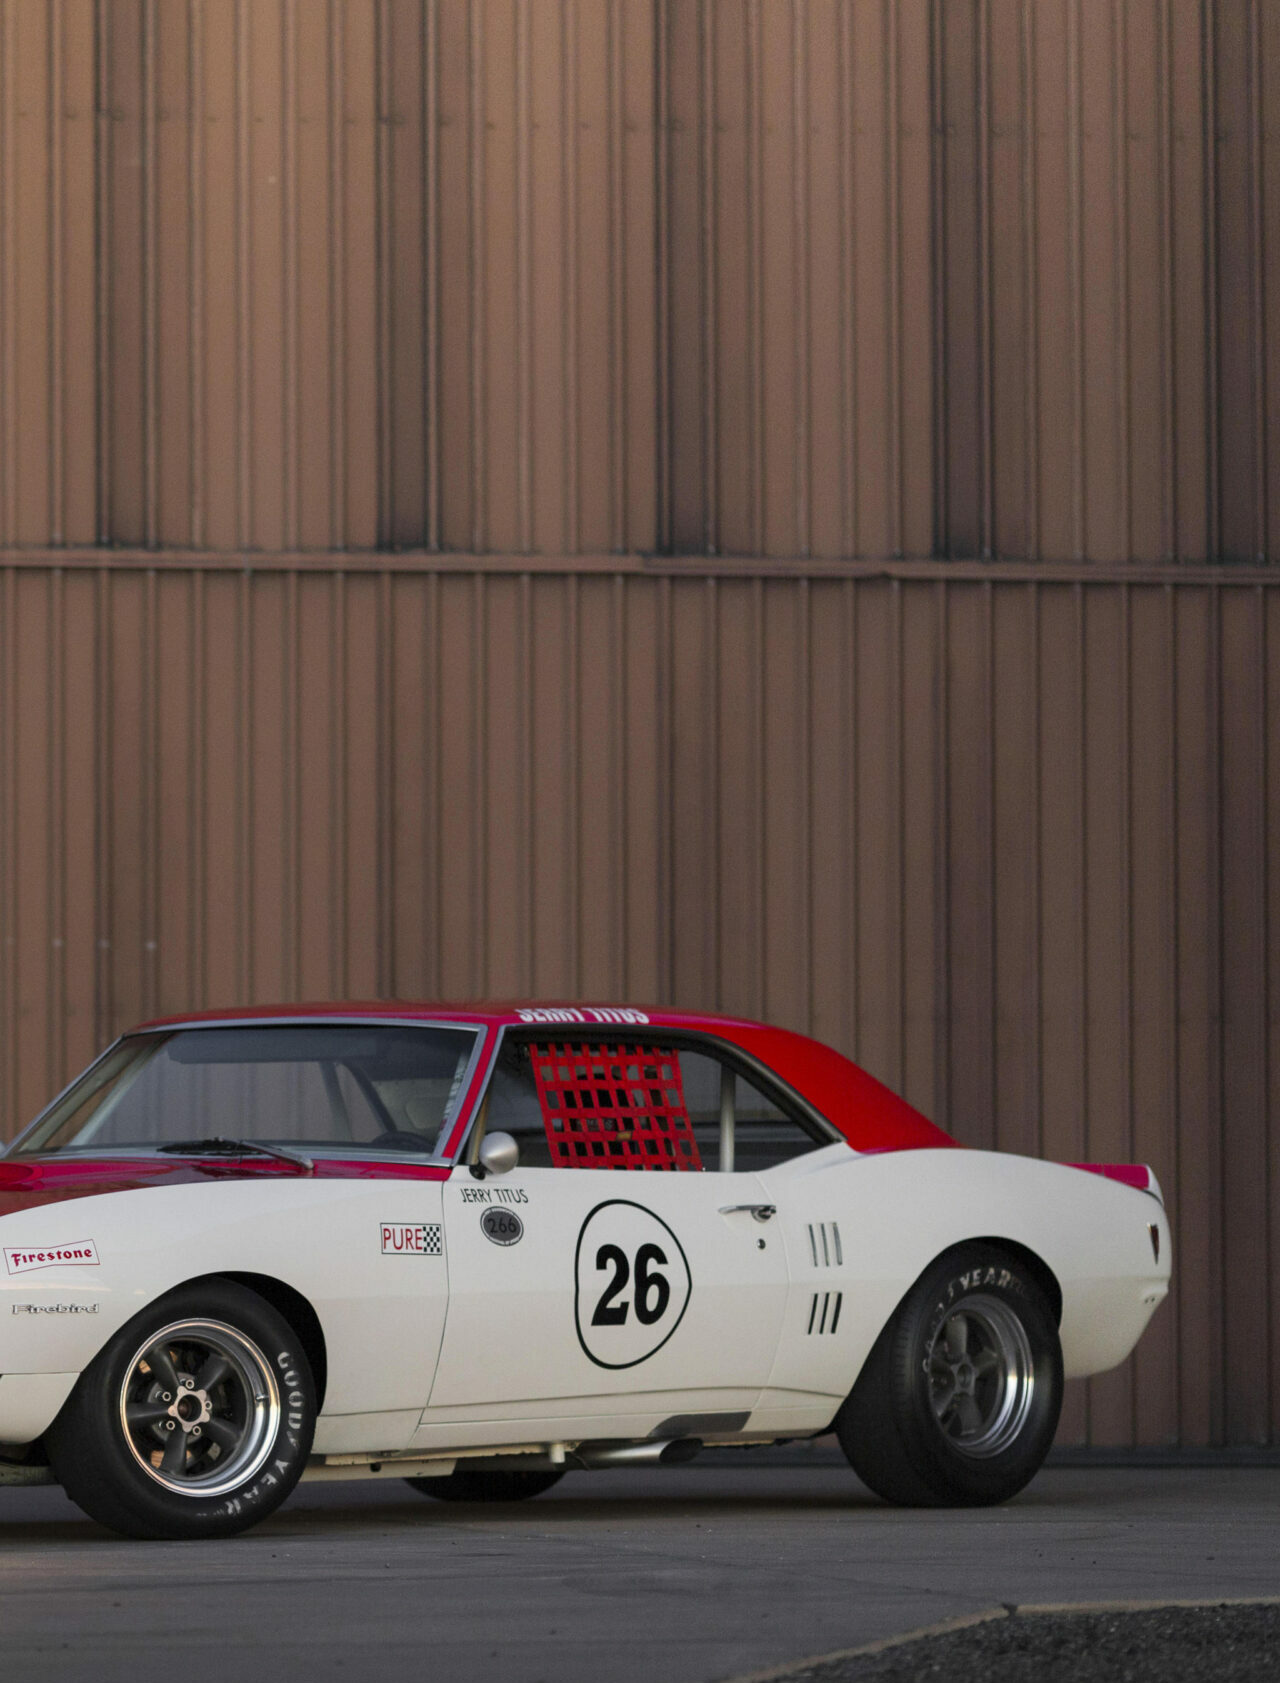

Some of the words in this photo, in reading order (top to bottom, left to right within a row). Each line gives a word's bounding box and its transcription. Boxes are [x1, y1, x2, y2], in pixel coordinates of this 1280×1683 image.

[460, 1188, 492, 1203] JERRY
[493, 1188, 529, 1204] TITUS
[487, 1217, 517, 1233] 266
[383, 1228, 423, 1250] PURE
[11, 1249, 92, 1267] Firestone
[591, 1243, 670, 1326] 26
[12, 1303, 100, 1315] Firebird
